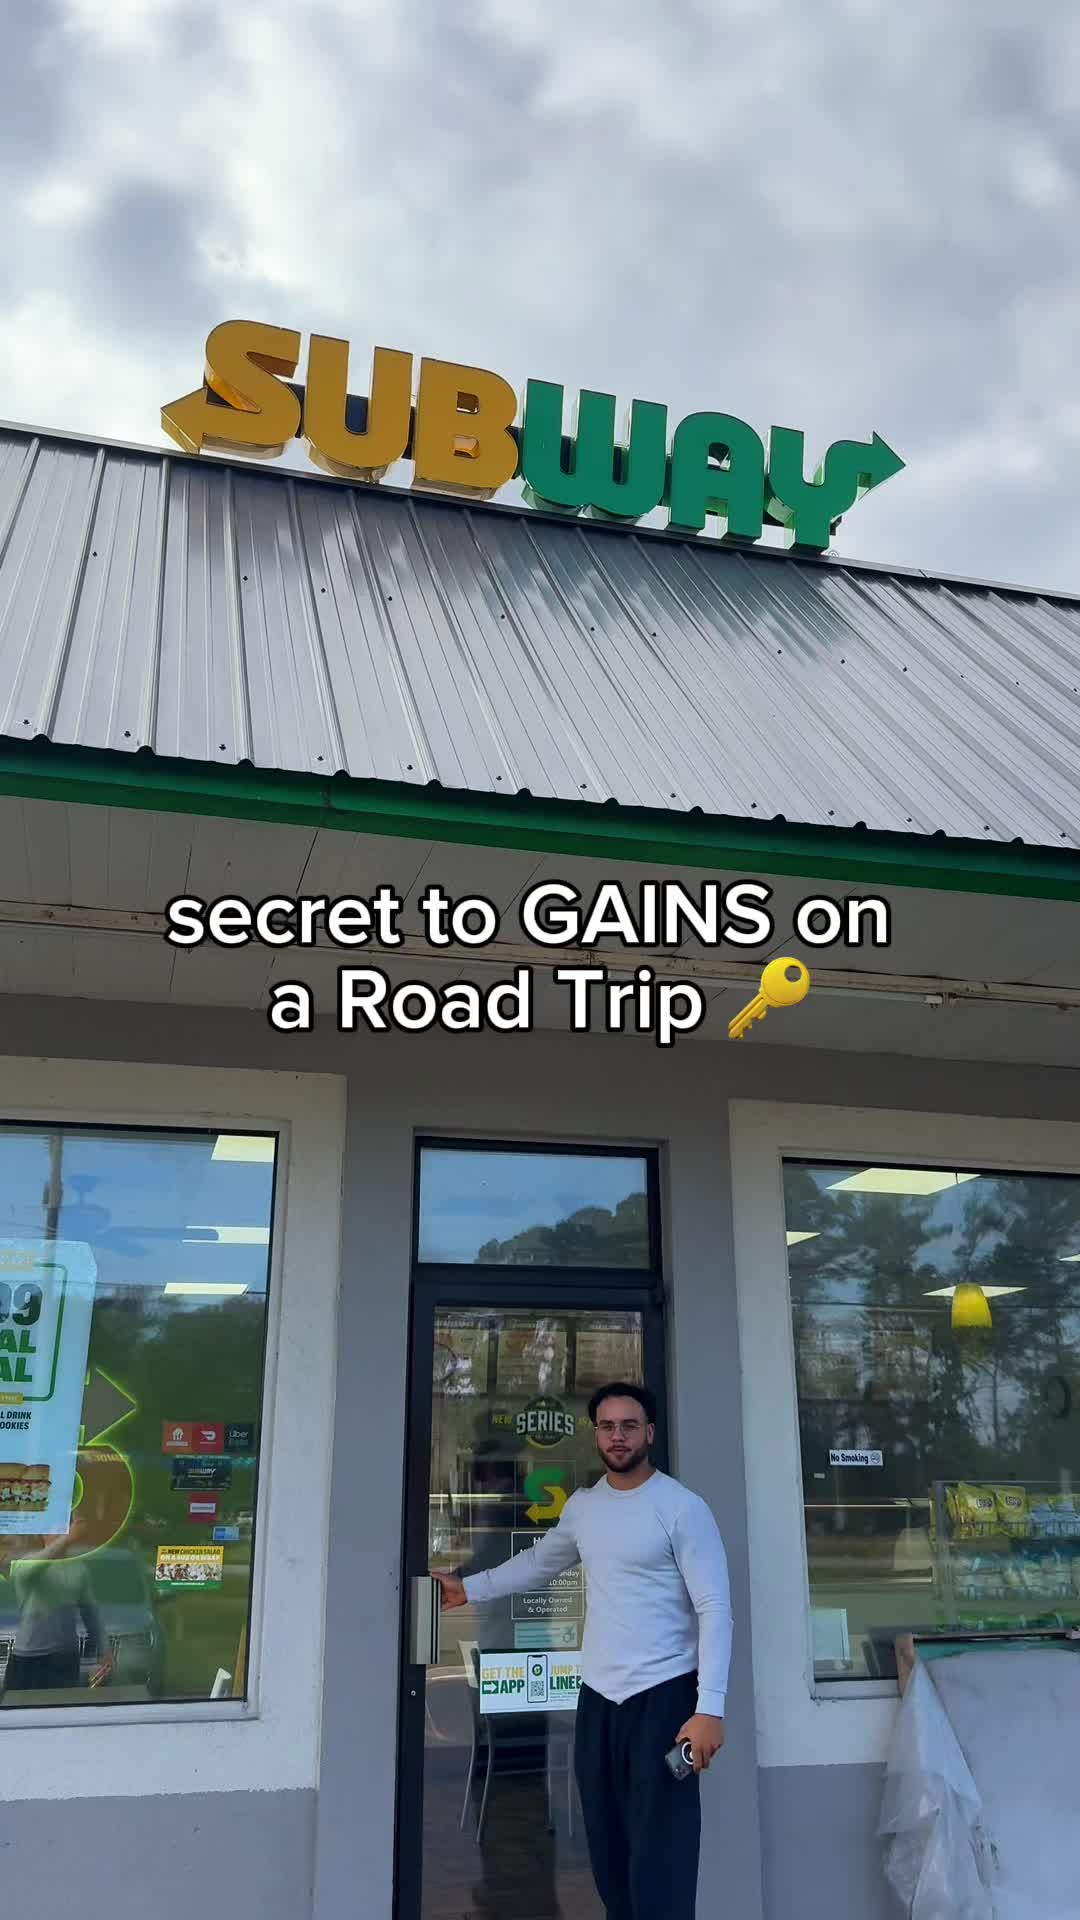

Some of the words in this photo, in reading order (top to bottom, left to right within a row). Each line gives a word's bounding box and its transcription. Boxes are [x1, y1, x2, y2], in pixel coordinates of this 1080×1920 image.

[162, 319, 905, 550] SUBWAY
[6, 1411, 32, 1420] DRINK
[516, 1410, 574, 1436] SERIES
[831, 1453, 840, 1462] No
[841, 1453, 869, 1464] Smoking
[523, 1597, 547, 1605] Locally
[535, 1606, 568, 1614] Operated
[481, 1667, 502, 1679] GET
[505, 1666, 525, 1678] THE
[551, 1664, 574, 1675] JUMP
[500, 1679, 525, 1694] APP
